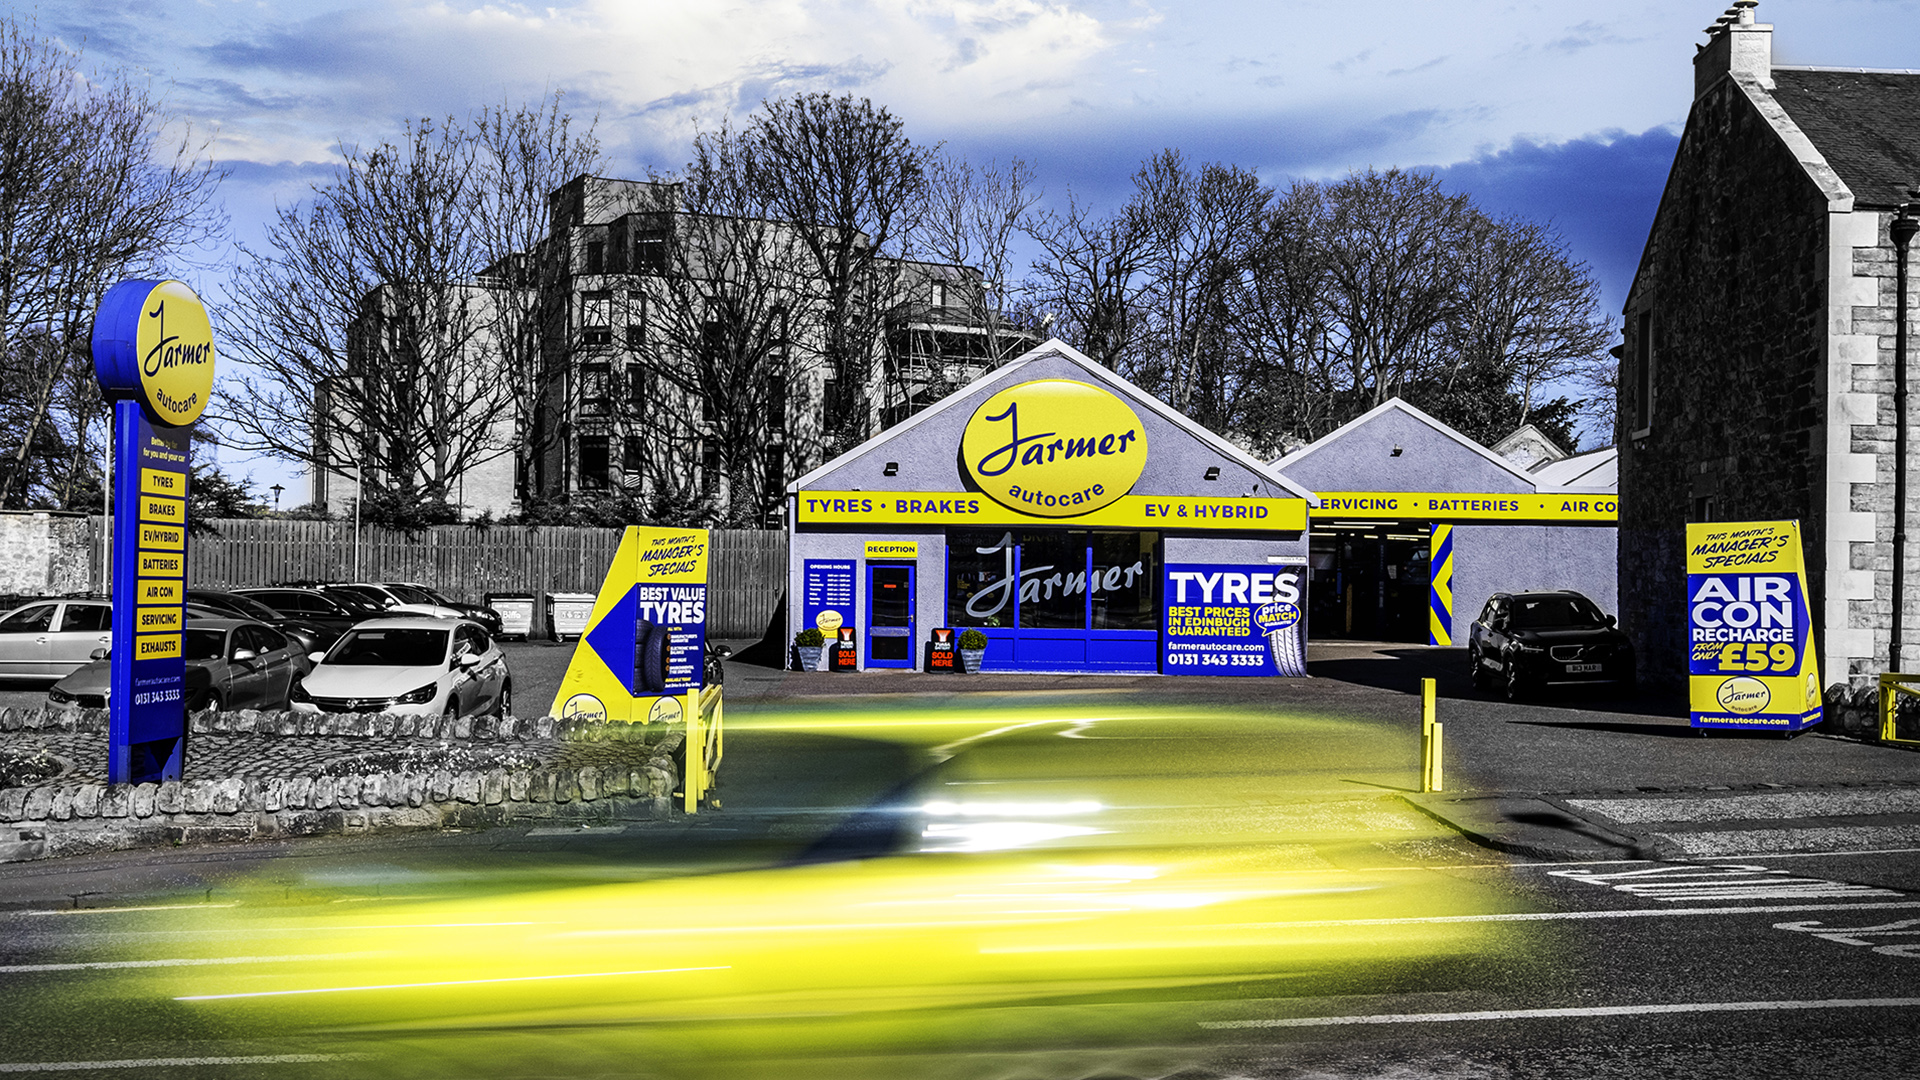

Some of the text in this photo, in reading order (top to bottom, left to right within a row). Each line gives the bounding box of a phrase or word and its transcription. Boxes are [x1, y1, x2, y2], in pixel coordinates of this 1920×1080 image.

[143, 300, 210, 377] Farmer
[157, 389, 197, 413] autocare
[977, 402, 1136, 476] Farmer
[153, 475, 173, 488] TYRES
[1008, 483, 1105, 507] autocare
[149, 503, 175, 516] BRAKES
[807, 499, 979, 514] TYRES BRAKES
[1145, 504, 1268, 518] EV & HYBRID
[1429, 499, 1519, 511] BATTERIES
[1561, 501, 1617, 512] AIR CO
[144, 530, 179, 543] EV/HYBRID
[1706, 527, 1774, 541] THIS MONTH'S
[652, 538, 666, 546] THIS
[1691, 535, 1790, 556] MANAGER'S
[640, 544, 704, 562] MANAGER'S
[1703, 550, 1779, 569] SPECIALS
[143, 558, 178, 570] BATTERIES
[648, 560, 697, 577] SPECIALS
[965, 531, 1143, 618] Farmer
[147, 586, 174, 598] AIR CON
[640, 586, 705, 601] BEST VALUE
[1169, 571, 1300, 604] TYRES
[1692, 577, 1791, 602] AIR
[640, 601, 705, 624] TYRES
[1168, 606, 1250, 618] BEST PRICES
[1262, 602, 1292, 616] price
[1692, 601, 1793, 629] CON
[142, 613, 177, 626] SERVICING
[1168, 617, 1250, 627] IN EDINBUGH
[1258, 611, 1297, 623] MATCH
[1168, 626, 1251, 636] GUARANTEED
[1692, 628, 1794, 642] RECHARGE
[141, 641, 176, 653] EXHAUSTS
[1168, 641, 1265, 652] farmerautocare.com
[1692, 642, 1724, 652] FROM
[838, 650, 857, 658] SOLD
[1168, 653, 1265, 666] 0131 343 3333
[1692, 651, 1720, 661] ONLY
[1718, 642, 1796, 672] £59
[838, 658, 856, 666] HERE
[931, 659, 953, 667] HERE
[135, 689, 180, 705] 0131 343 3333
[1722, 684, 1766, 704] Farmer
[1700, 716, 1790, 725] farmerautocare.com
